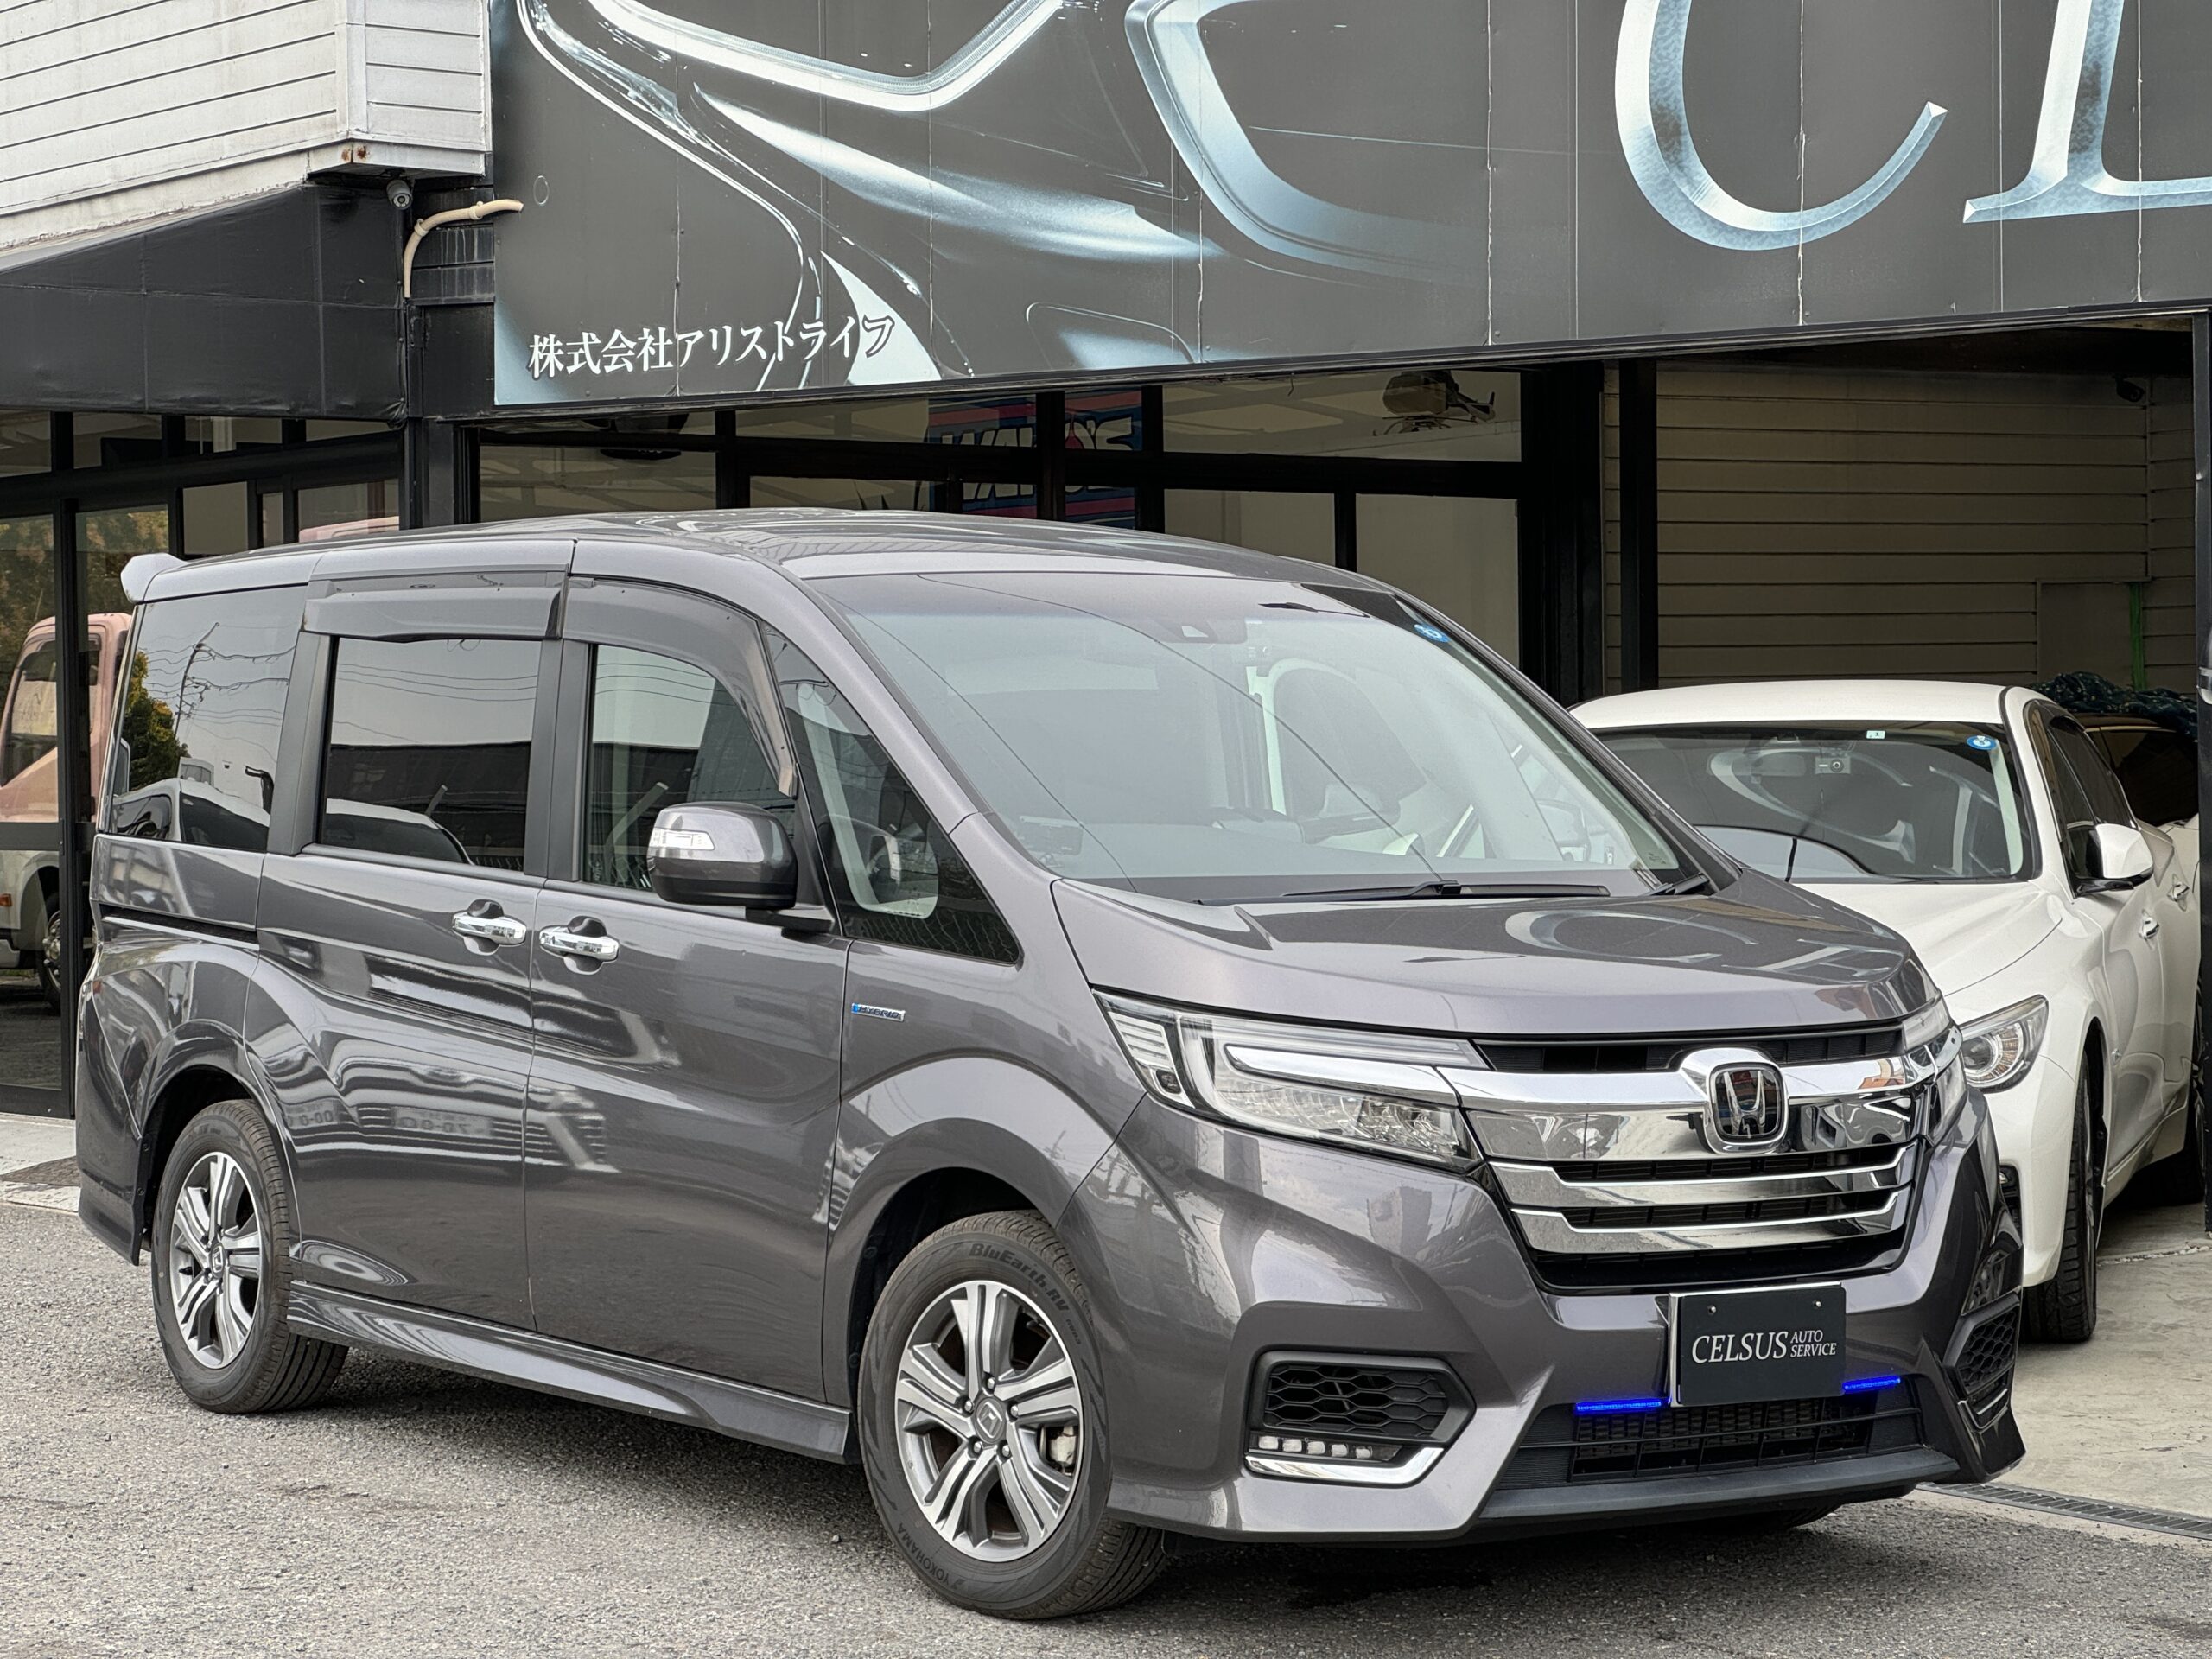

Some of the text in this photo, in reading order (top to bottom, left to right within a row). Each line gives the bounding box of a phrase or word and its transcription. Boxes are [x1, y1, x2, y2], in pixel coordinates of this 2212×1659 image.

[528, 315, 896, 378] 株式会社アリストライフ
[859, 1005, 899, 1019] HYBRID
[1691, 1329, 1823, 1363] CELSUS AUTO
[1789, 1342, 1837, 1358] SERVICE
[898, 1522, 950, 1586] YOKOHAMA
